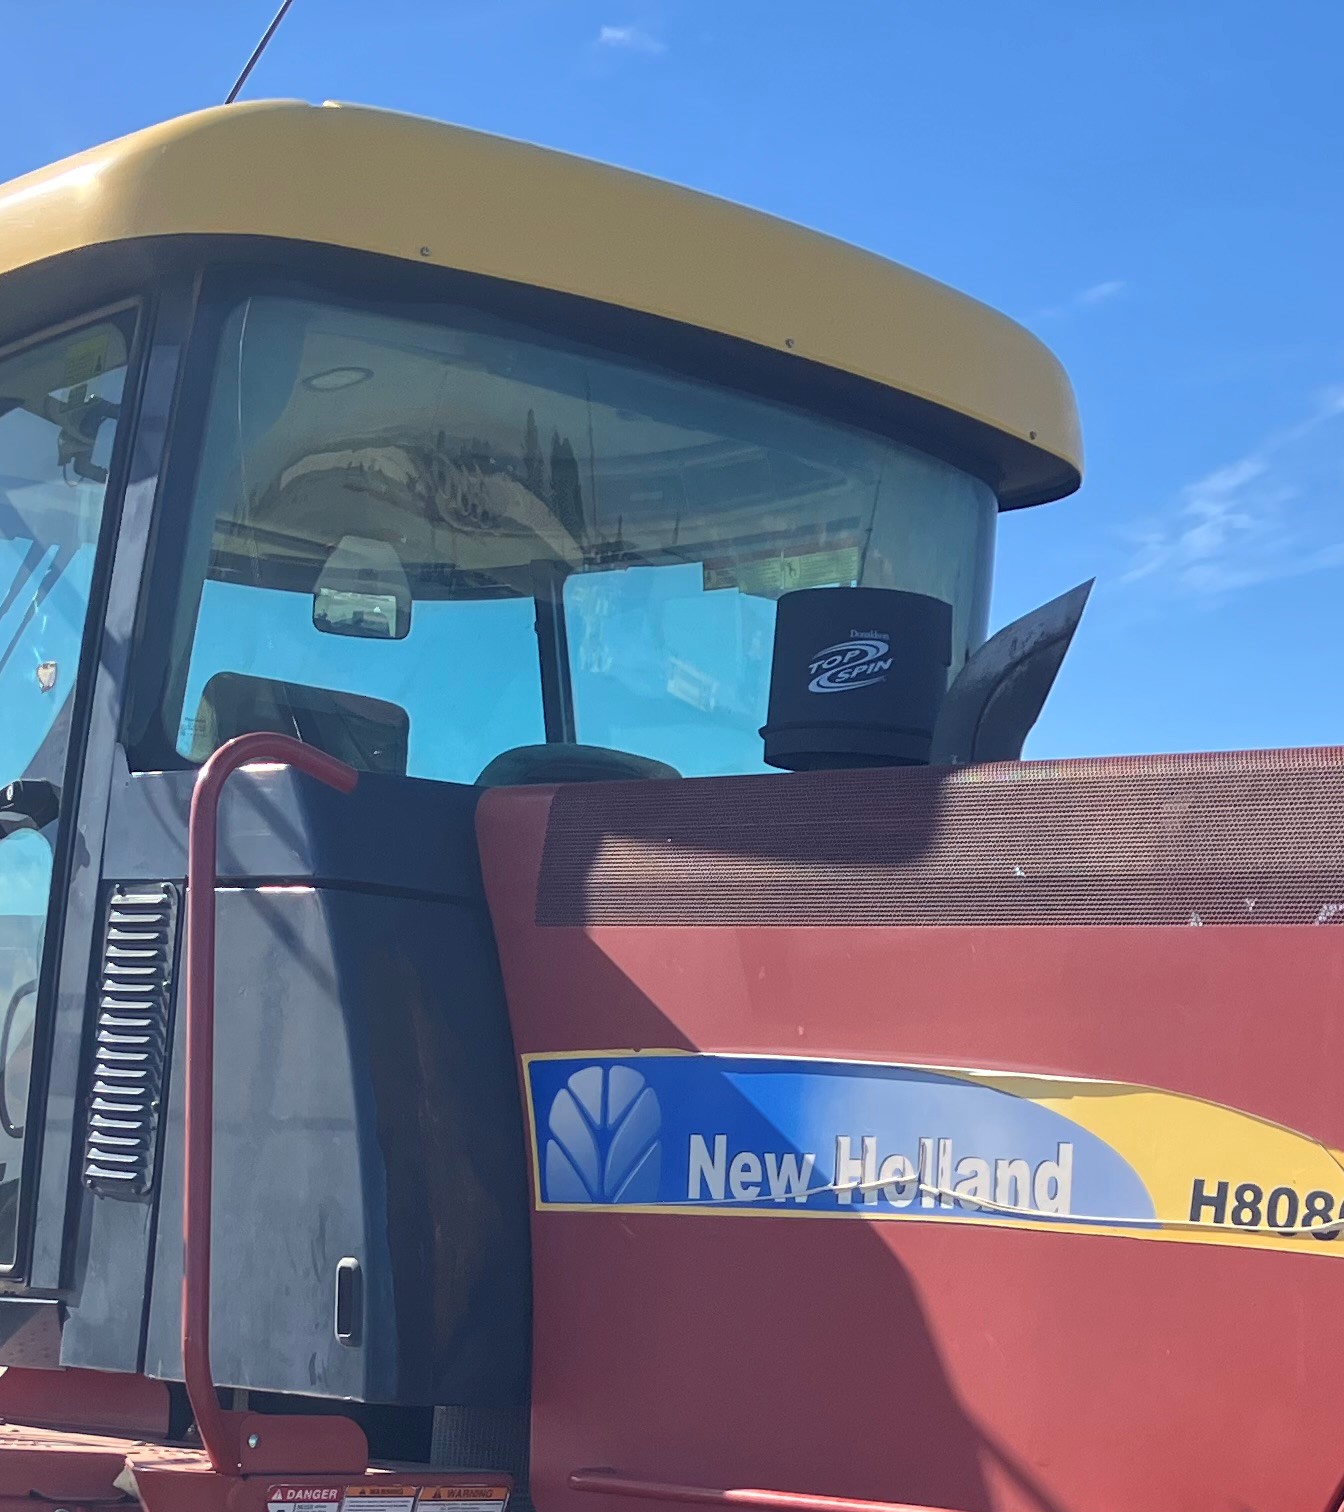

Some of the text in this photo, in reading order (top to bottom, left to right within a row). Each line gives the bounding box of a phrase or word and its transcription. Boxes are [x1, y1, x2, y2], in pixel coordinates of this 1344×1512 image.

[808, 649, 862, 675] TOP
[834, 657, 894, 683] SPIN
[687, 1132, 1074, 1217] New Holland
[286, 1488, 338, 1500] DANGER
[446, 1488, 494, 1499] WARNING
